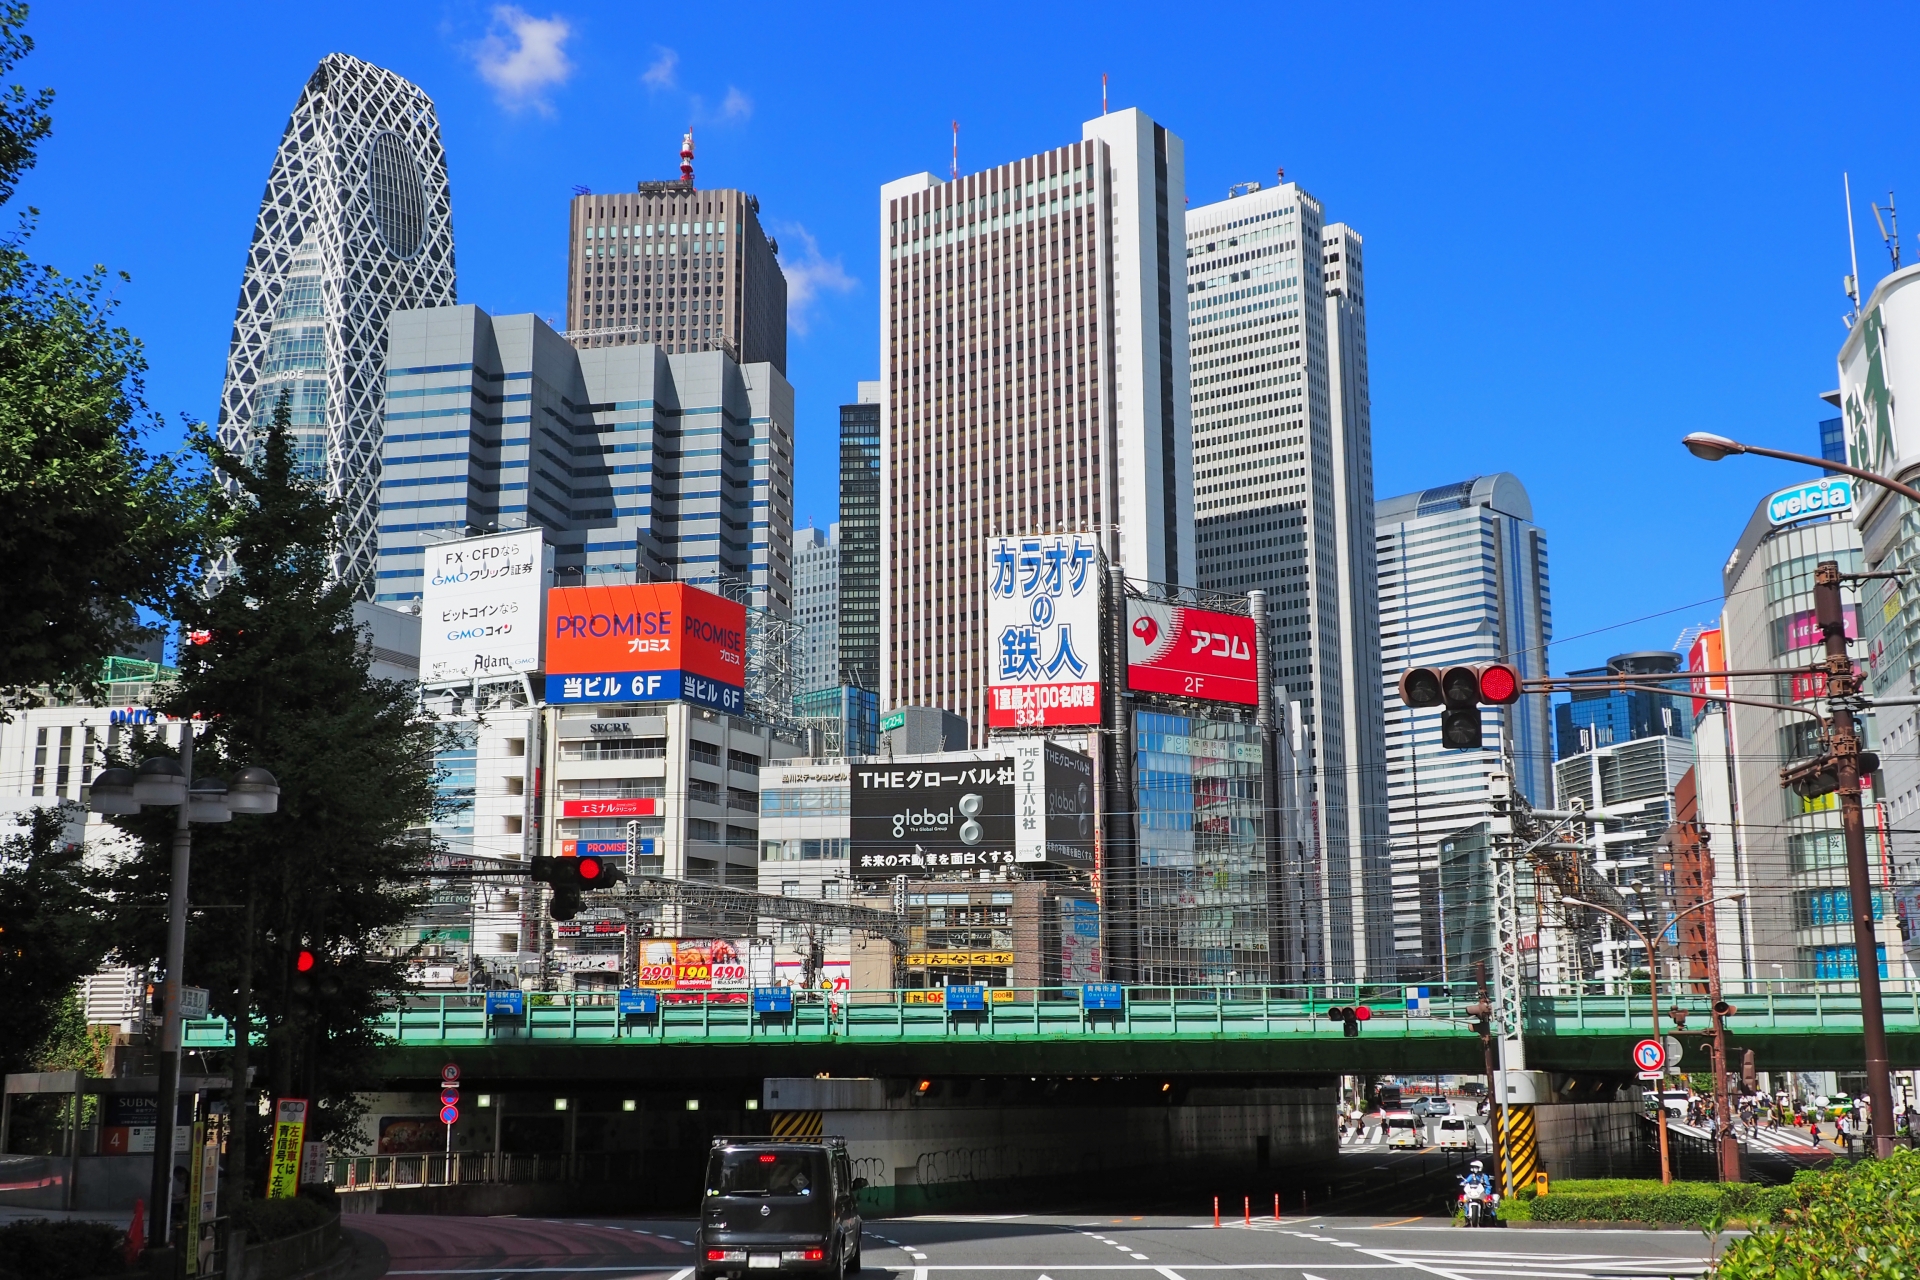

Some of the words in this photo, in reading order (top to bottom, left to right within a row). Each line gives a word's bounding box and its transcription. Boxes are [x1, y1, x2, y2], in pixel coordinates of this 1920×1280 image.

[275, 370, 305, 381] MODE
[1772, 481, 1846, 519] welcia
[431, 563, 533, 586] GMOクリック証券
[990, 535, 1095, 600] カラオケ
[442, 602, 519, 622] ビットコインなら
[1030, 591, 1055, 630] の
[447, 624, 513, 641] GMOコイン
[556, 611, 672, 639] PROMISE
[685, 615, 741, 653] PROMISE
[628, 638, 671, 653] プロミス
[998, 623, 1088, 682] 鉄人
[1190, 629, 1251, 661] アコム
[432, 662, 448, 670] NFT
[472, 654, 510, 675] Adam
[720, 649, 740, 666] プロミス
[563, 676, 622, 699] 当ビル
[631, 675, 662, 696] 6F
[684, 676, 718, 702] 当ビル
[723, 690, 740, 709] 6F
[1184, 676, 1205, 693] 2F
[993, 685, 1095, 710] 1室最大100名収容
[590, 722, 630, 733] SECRE
[1016, 708, 1046, 725] 334
[1045, 748, 1091, 776] THEグローバル社
[782, 773, 848, 784] 品川ステーションビル
[858, 766, 1015, 789] THEグローバル社
[1049, 788, 1077, 821] global
[892, 807, 954, 838] global
[564, 841, 575, 852] 6F
[587, 842, 627, 853] PROMISE
[758, 987, 787, 995] 青梅街道
[950, 986, 980, 994] 青梅街道
[1087, 985, 1117, 993] 青梅街道
[110, 1132, 120, 1147] 4
[285, 1125, 301, 1175] 左折車は
[271, 1125, 290, 1199] 青信号で左折
